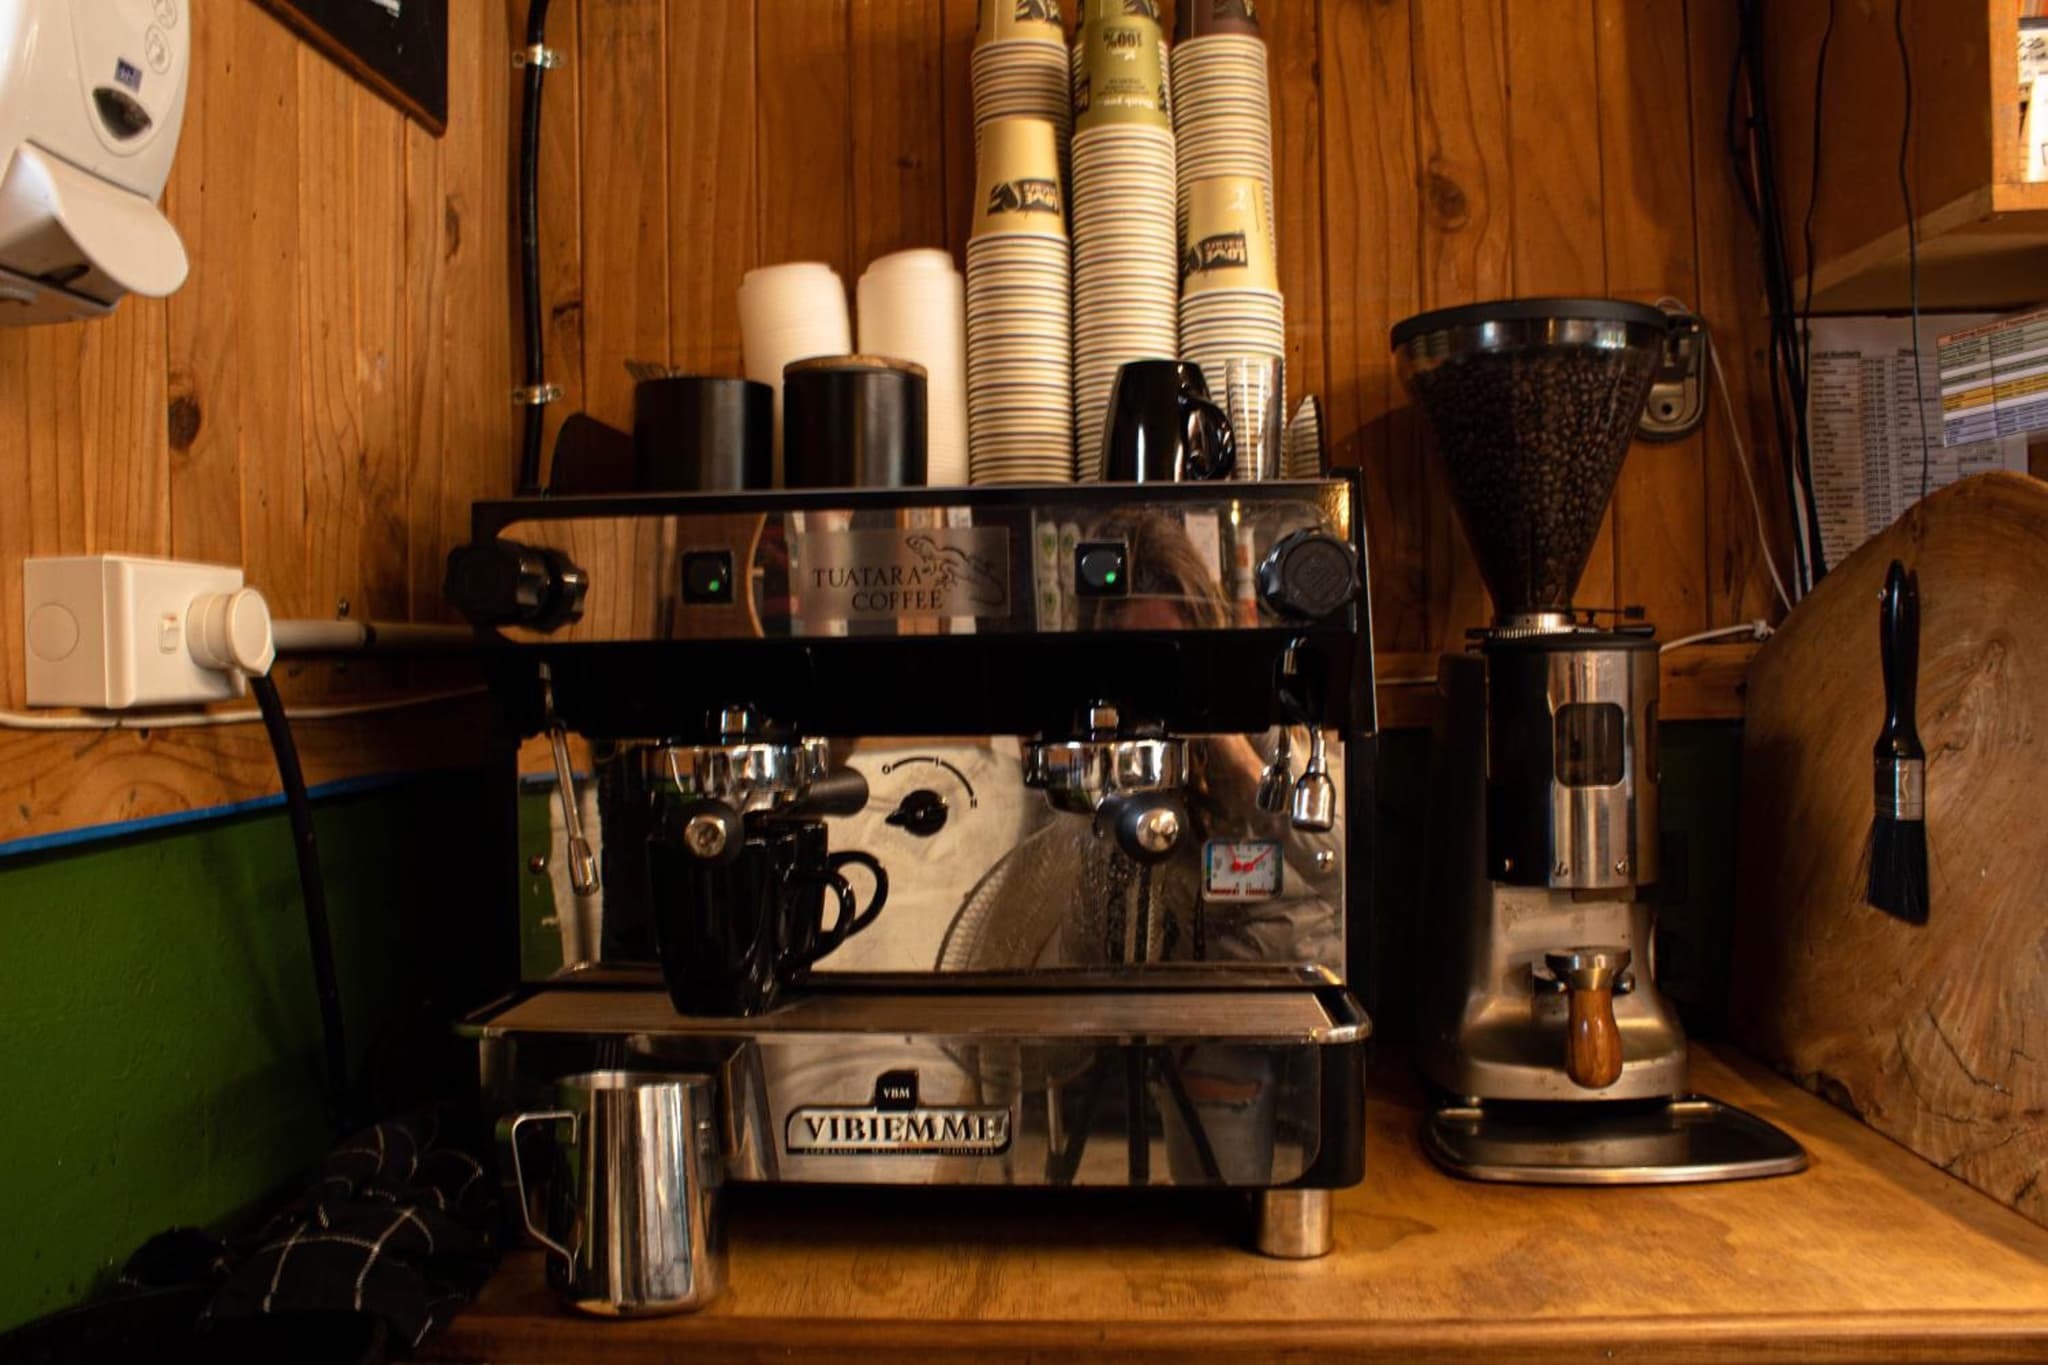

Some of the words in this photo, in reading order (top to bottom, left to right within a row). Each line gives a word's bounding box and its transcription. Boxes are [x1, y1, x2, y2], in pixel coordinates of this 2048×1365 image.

[812, 566, 923, 588] TUATARA
[852, 590, 944, 611] COFFEE
[883, 1087, 911, 1099] VBM
[803, 1115, 1000, 1141] VIBIEMME
